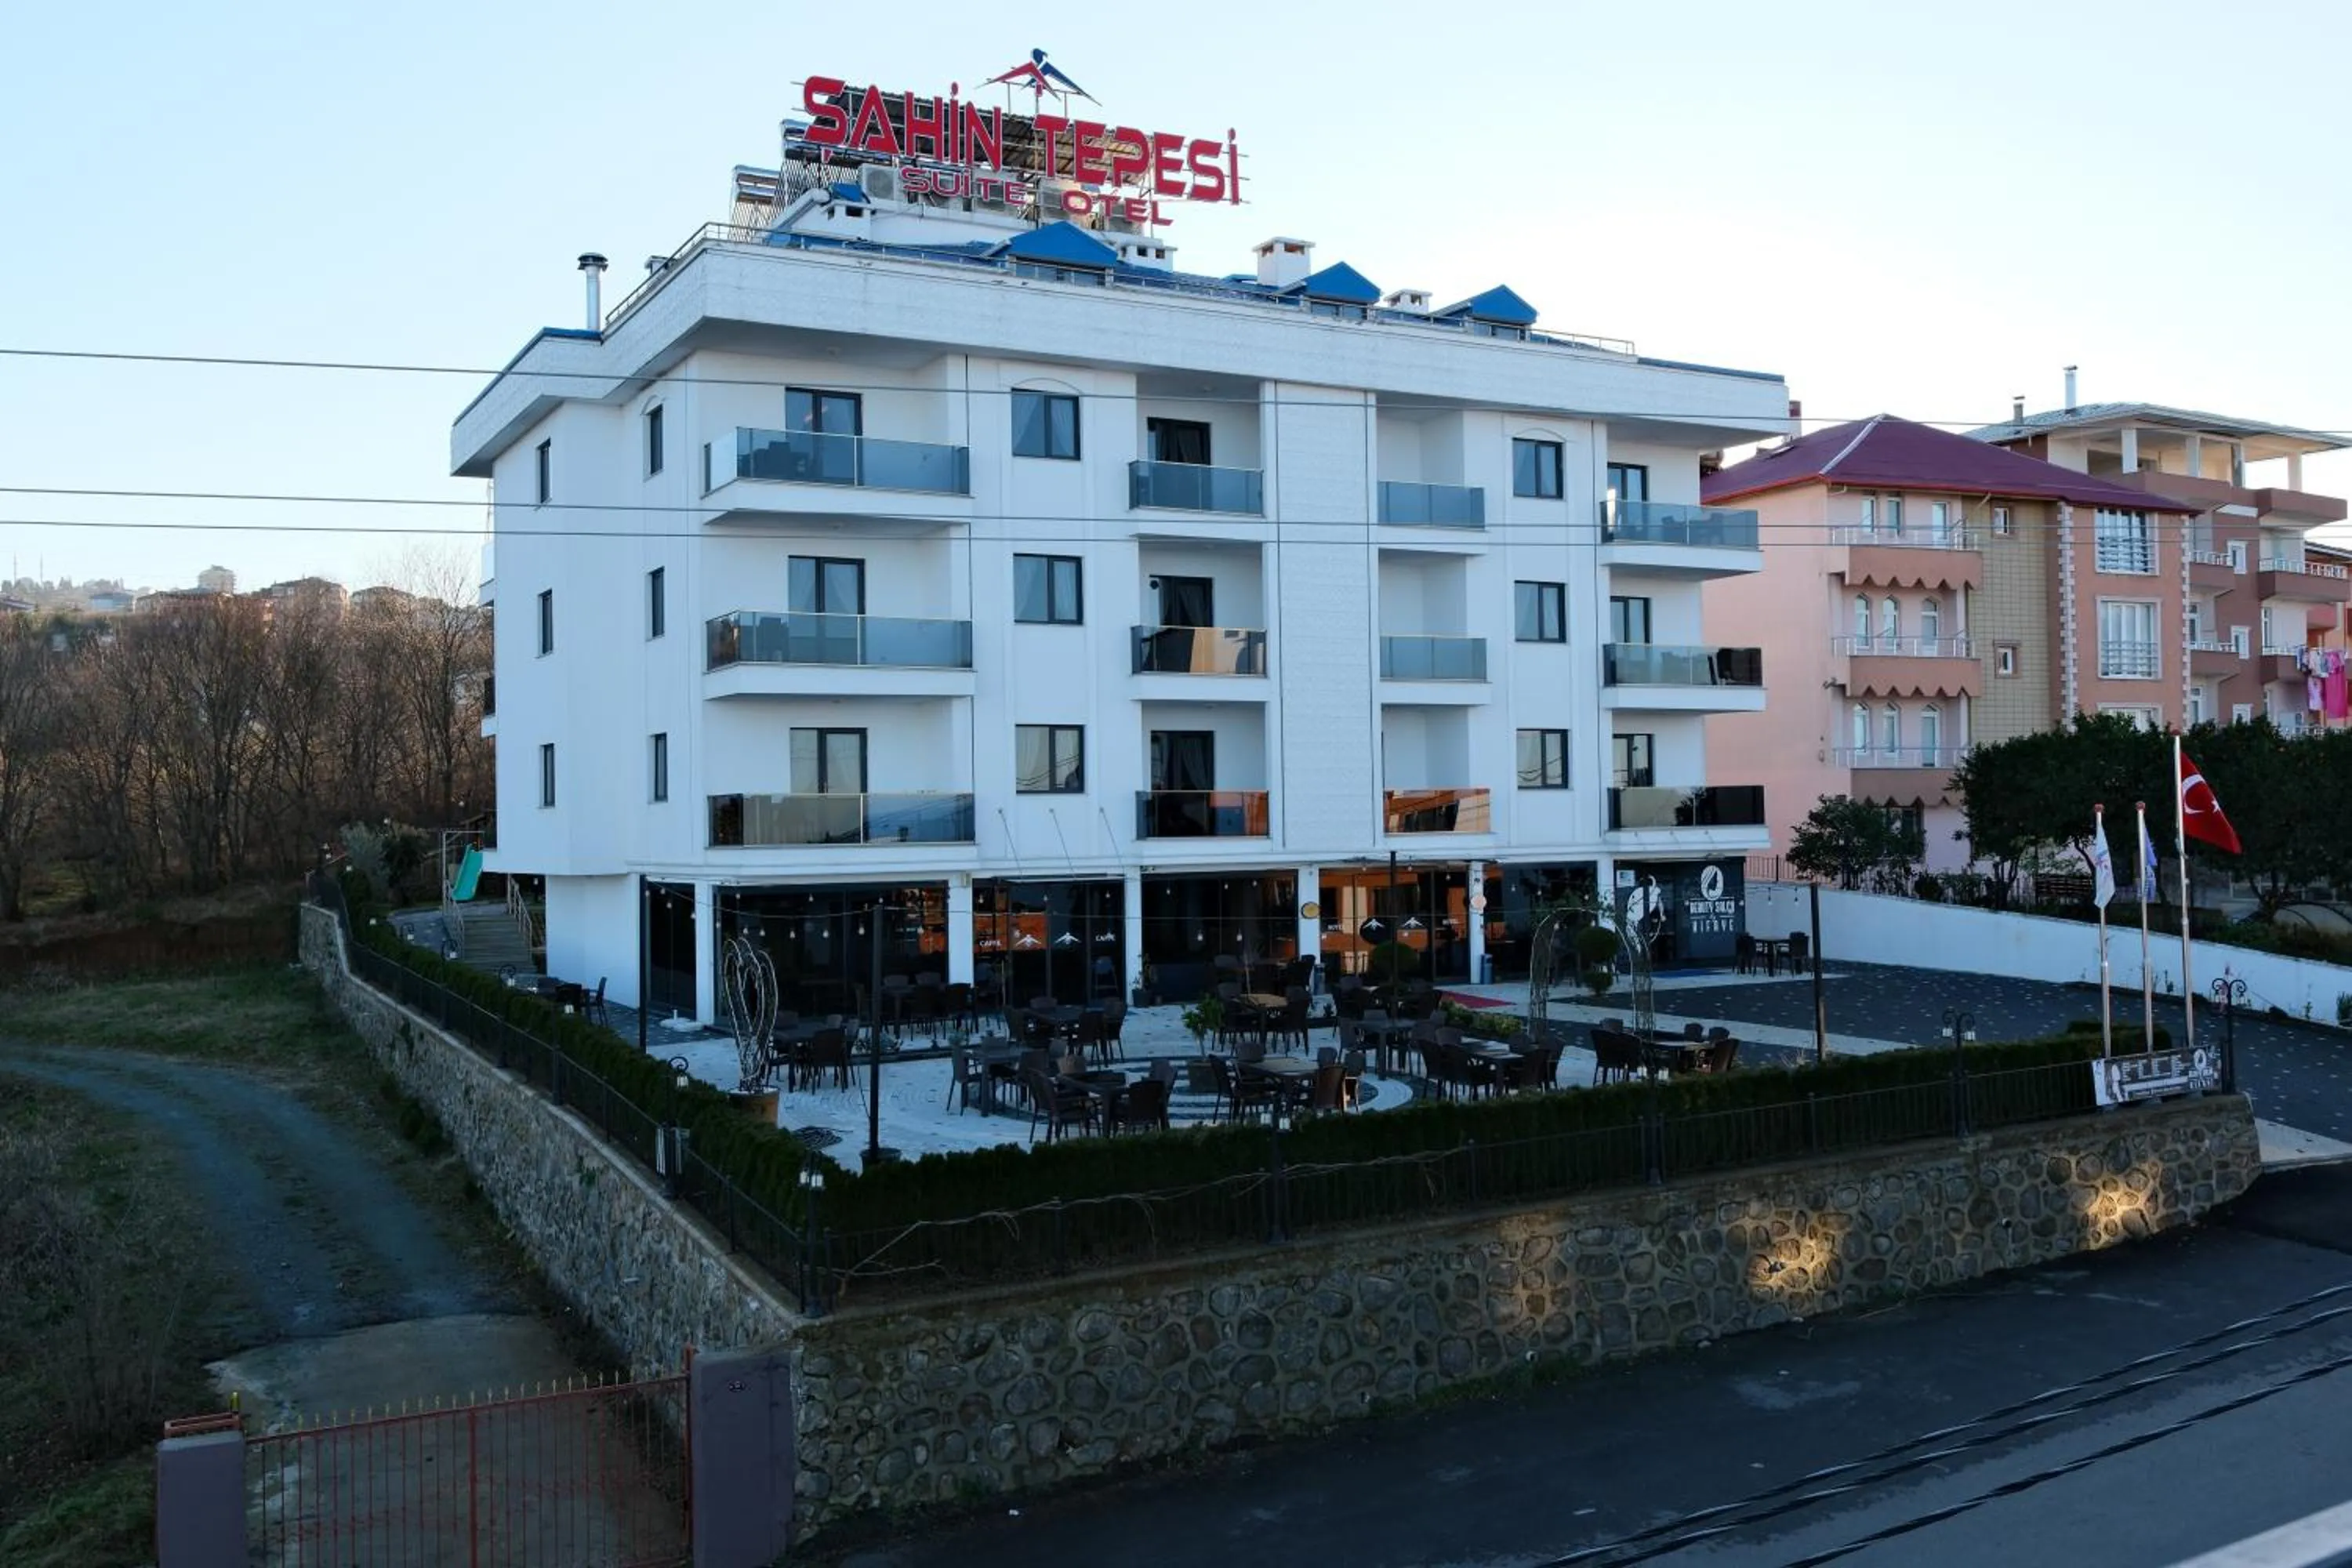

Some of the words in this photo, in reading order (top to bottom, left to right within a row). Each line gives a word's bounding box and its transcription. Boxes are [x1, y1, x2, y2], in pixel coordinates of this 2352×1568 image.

[804, 75, 1003, 172] ŞAHİN
[1032, 114, 1240, 205] TEPESİ
[1061, 189, 1174, 227] OTEL
